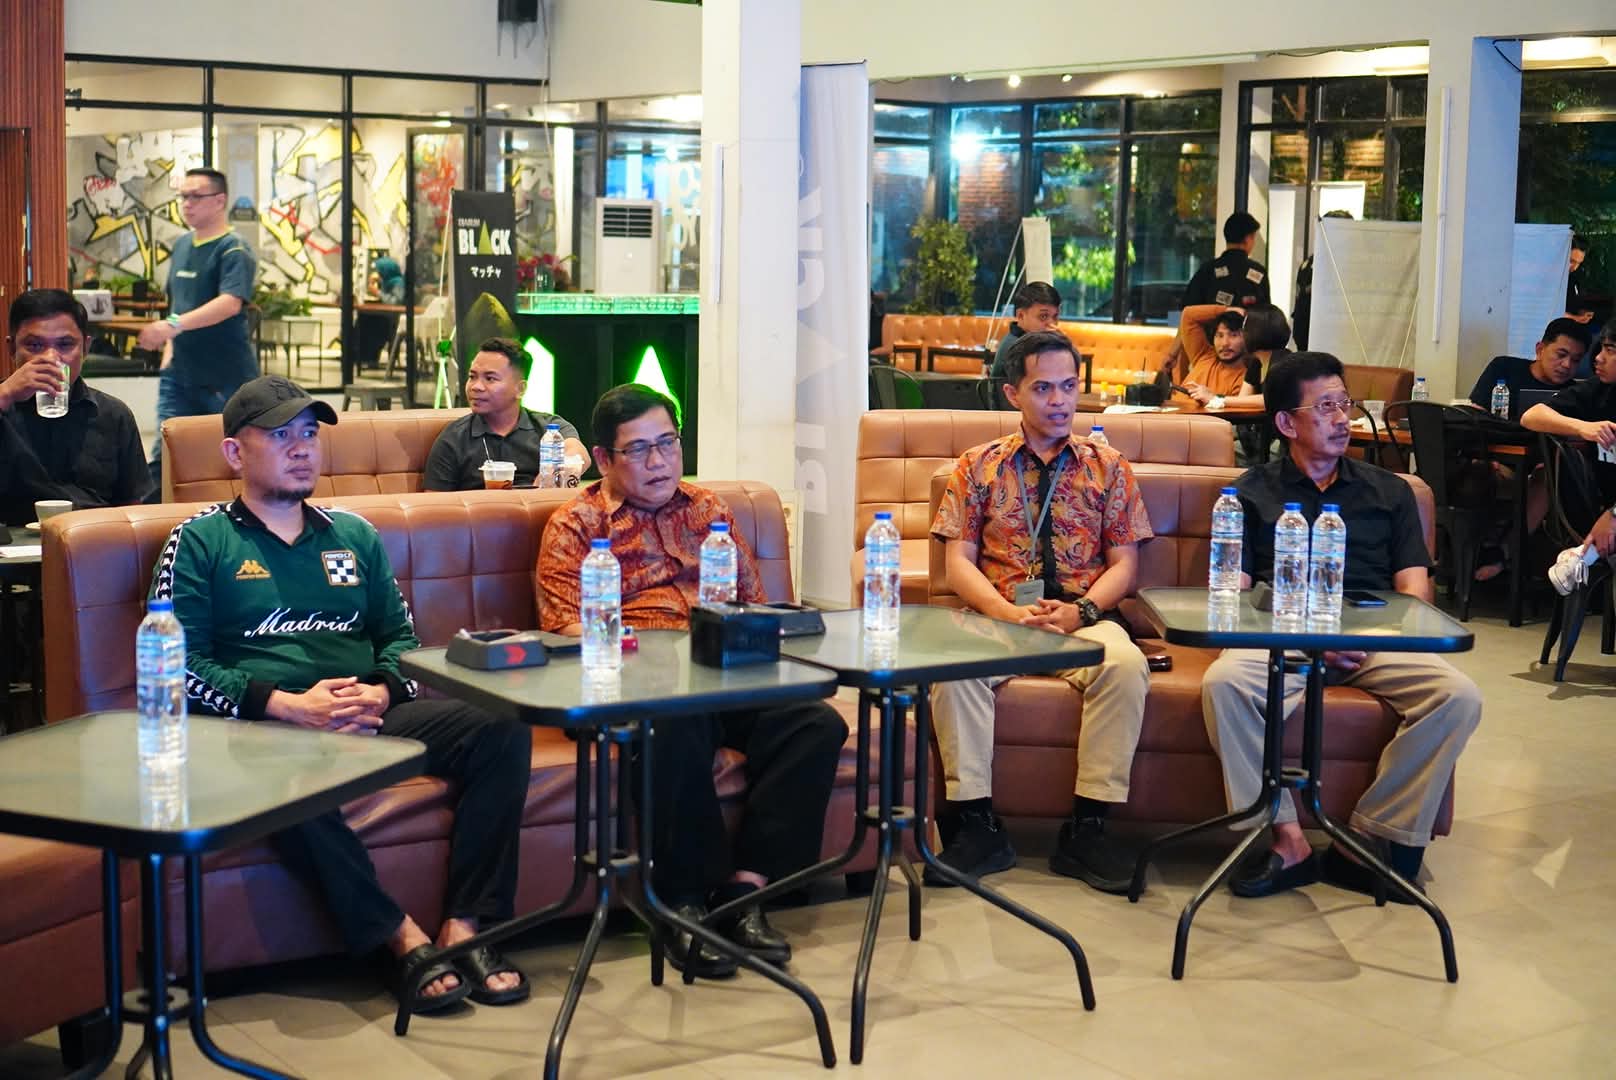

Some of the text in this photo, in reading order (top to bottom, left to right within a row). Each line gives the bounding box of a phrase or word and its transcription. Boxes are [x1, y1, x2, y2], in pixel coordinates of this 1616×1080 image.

[458, 220, 512, 256] BLACK
[470, 264, 502, 279] マッチャ
[243, 607, 359, 638] Madrid
